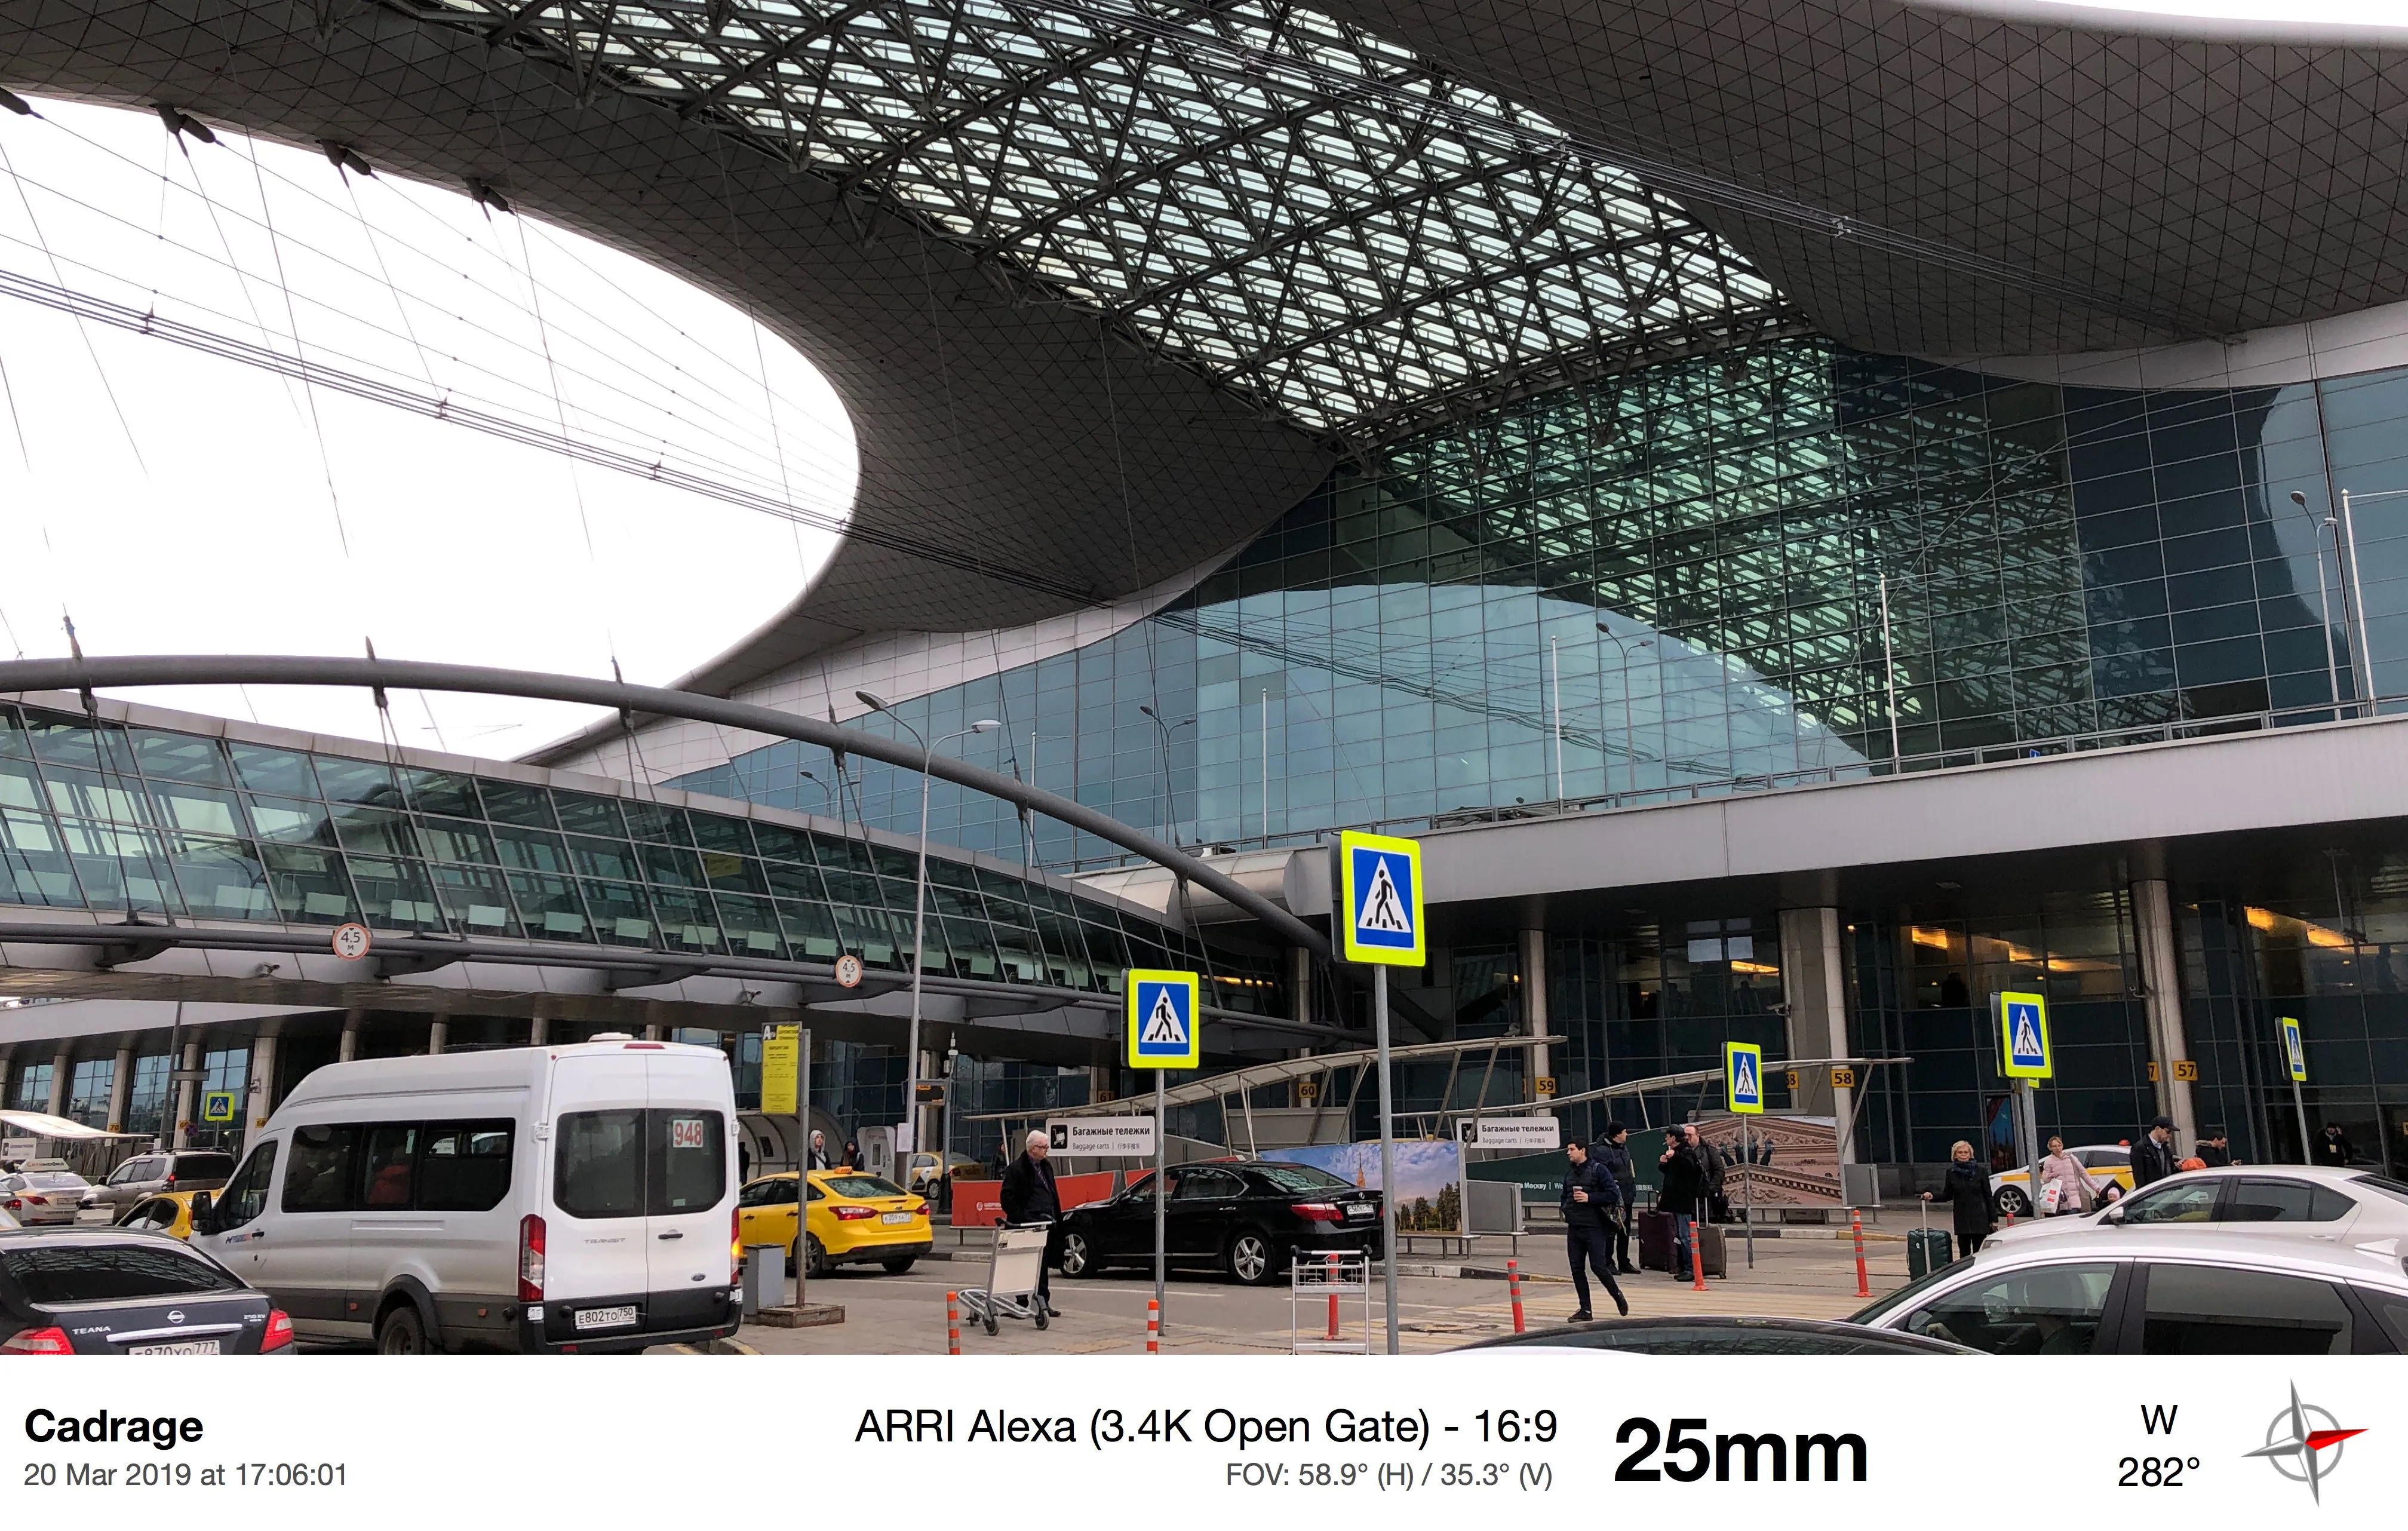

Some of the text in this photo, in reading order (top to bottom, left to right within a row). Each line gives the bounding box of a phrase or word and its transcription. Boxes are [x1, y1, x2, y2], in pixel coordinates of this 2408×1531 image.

[2178, 1064, 2195, 1077] 57
[1835, 1072, 1852, 1084] 58
[1301, 1085, 1314, 1096] 60
[1539, 1080, 1554, 1091] 59
[675, 1122, 702, 1146] 948
[1073, 1127, 1113, 1136] Багажные
[1482, 1137, 1504, 1145] Baggage
[1072, 1142, 1095, 1151] Baggage
[1524, 1182, 1547, 1190] Москву
[619, 1307, 633, 1317] 750
[72, 1326, 112, 1335] TEANA
[195, 1342, 216, 1354] 777
